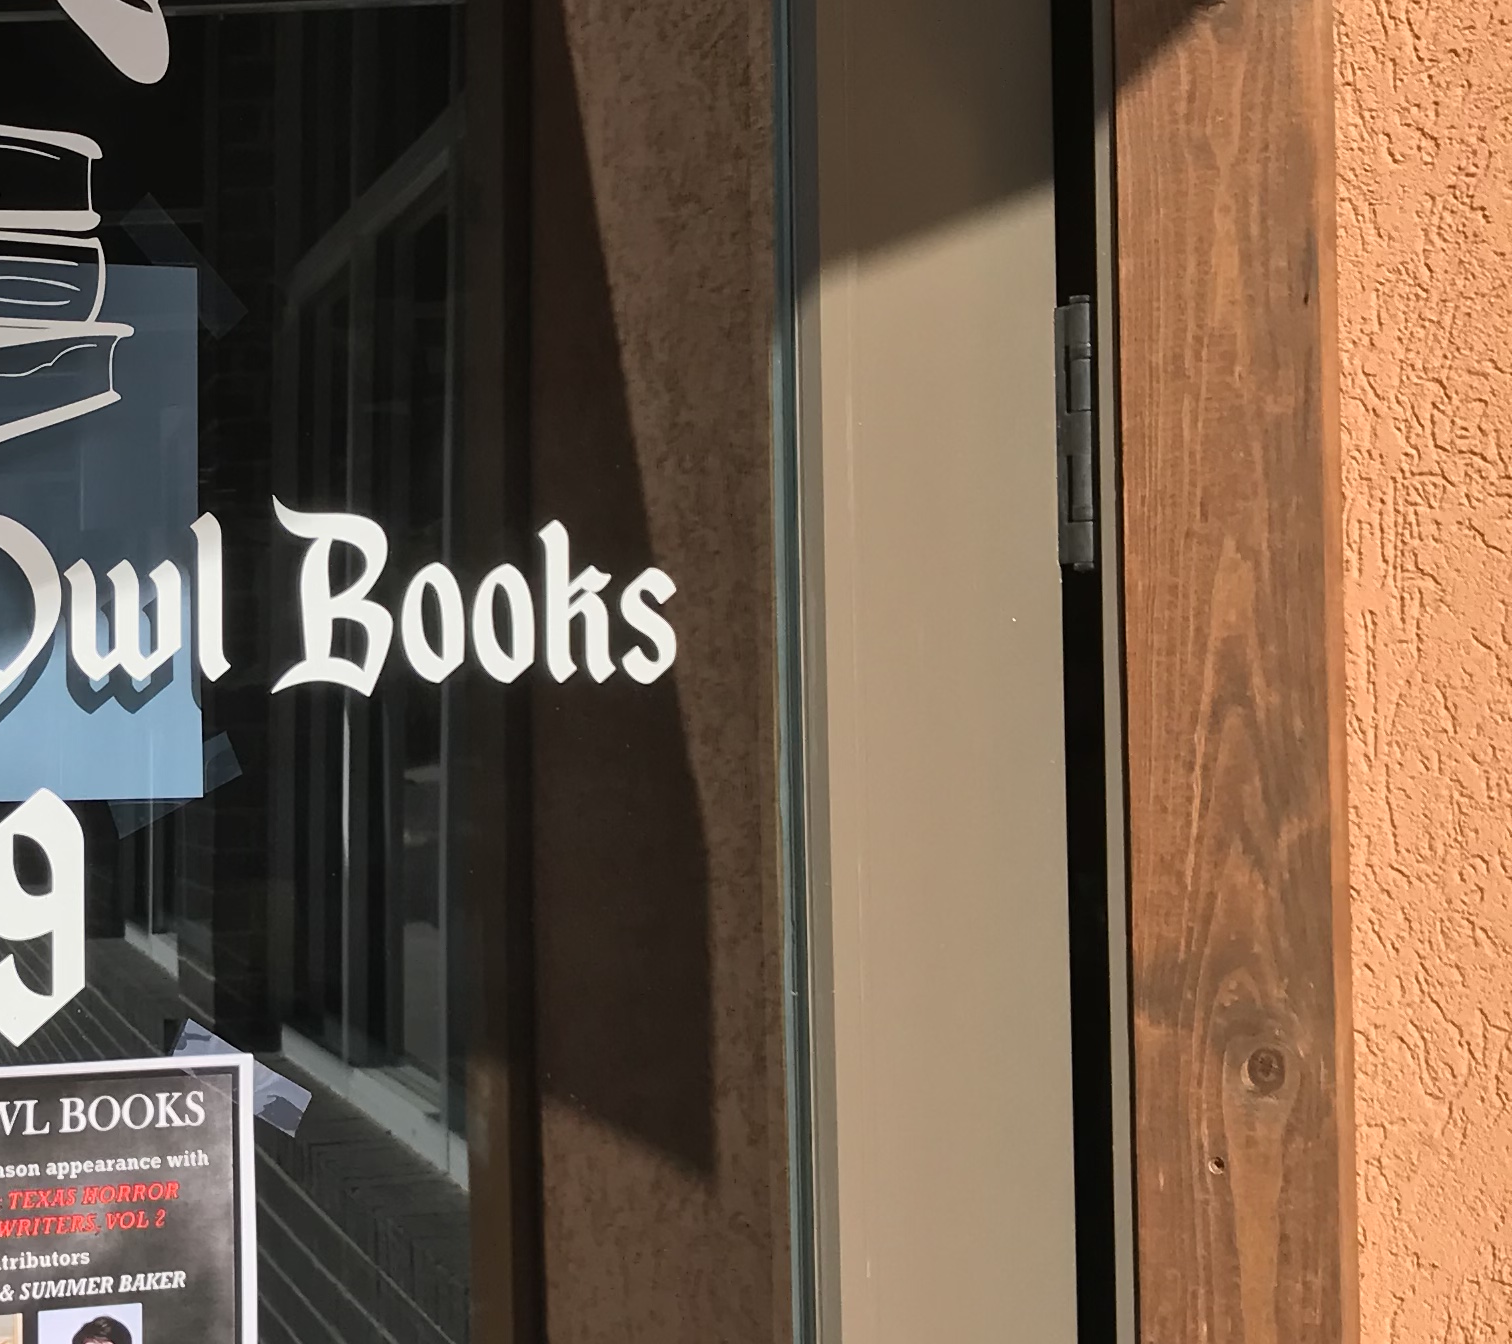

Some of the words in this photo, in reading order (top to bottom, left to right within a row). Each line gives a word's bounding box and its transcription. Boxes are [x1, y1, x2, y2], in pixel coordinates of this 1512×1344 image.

[271, 494, 677, 696] Books
[58, 1090, 206, 1134] BOOKS
[46, 1154, 162, 1179] appearance
[167, 1149, 210, 1168] with
[8, 1187, 77, 1209] TEXAS
[81, 1181, 180, 1205] HORROR
[106, 1209, 149, 1230] VOL
[155, 1208, 167, 1228] 2
[0, 1283, 15, 1302] &
[19, 1276, 114, 1301] SUMMER
[118, 1270, 187, 1293] BAKER
